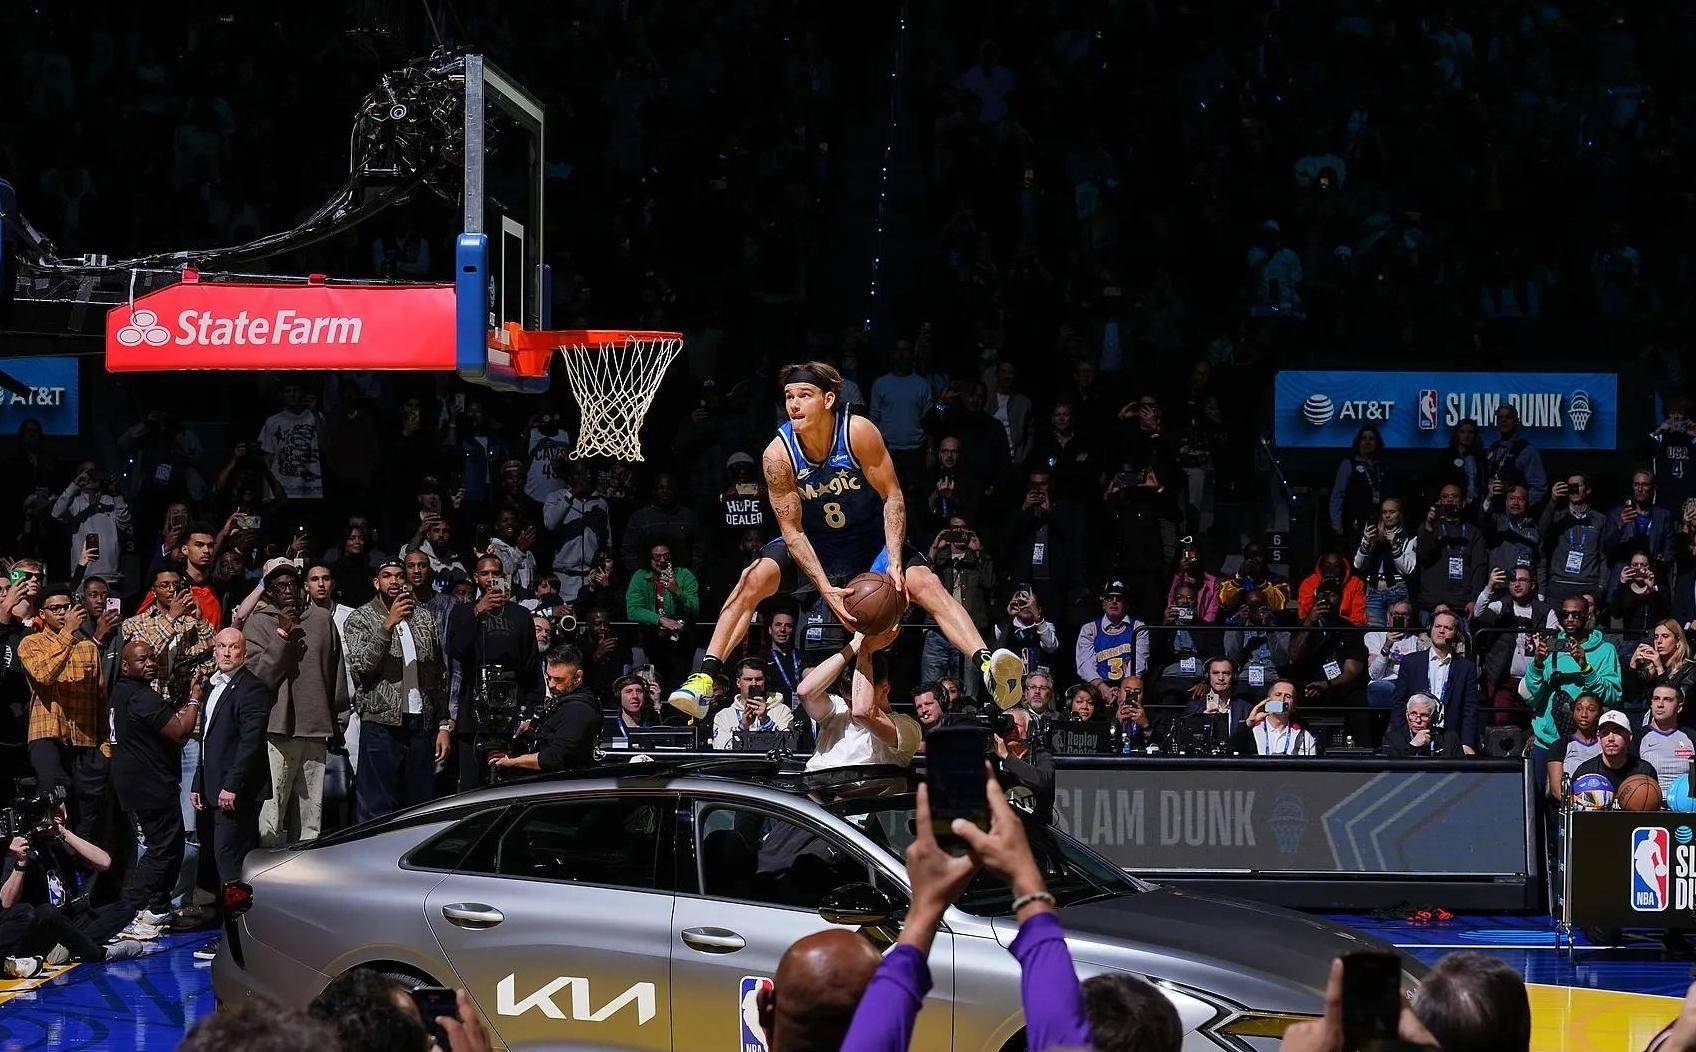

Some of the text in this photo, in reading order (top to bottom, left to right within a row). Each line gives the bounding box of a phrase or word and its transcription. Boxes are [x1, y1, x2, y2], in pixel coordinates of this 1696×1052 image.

[10, 386, 66, 406] AT&T
[1340, 400, 1395, 420] AT&T
[1446, 392, 1500, 427] SLAM
[725, 512, 763, 525] DEALER
[823, 502, 847, 529] 8
[1067, 731, 1099, 749] Replay
[1055, 788, 1256, 846] SLAM DUNK
[1636, 891, 1655, 906] NBA
[497, 972, 656, 1026] KIA
